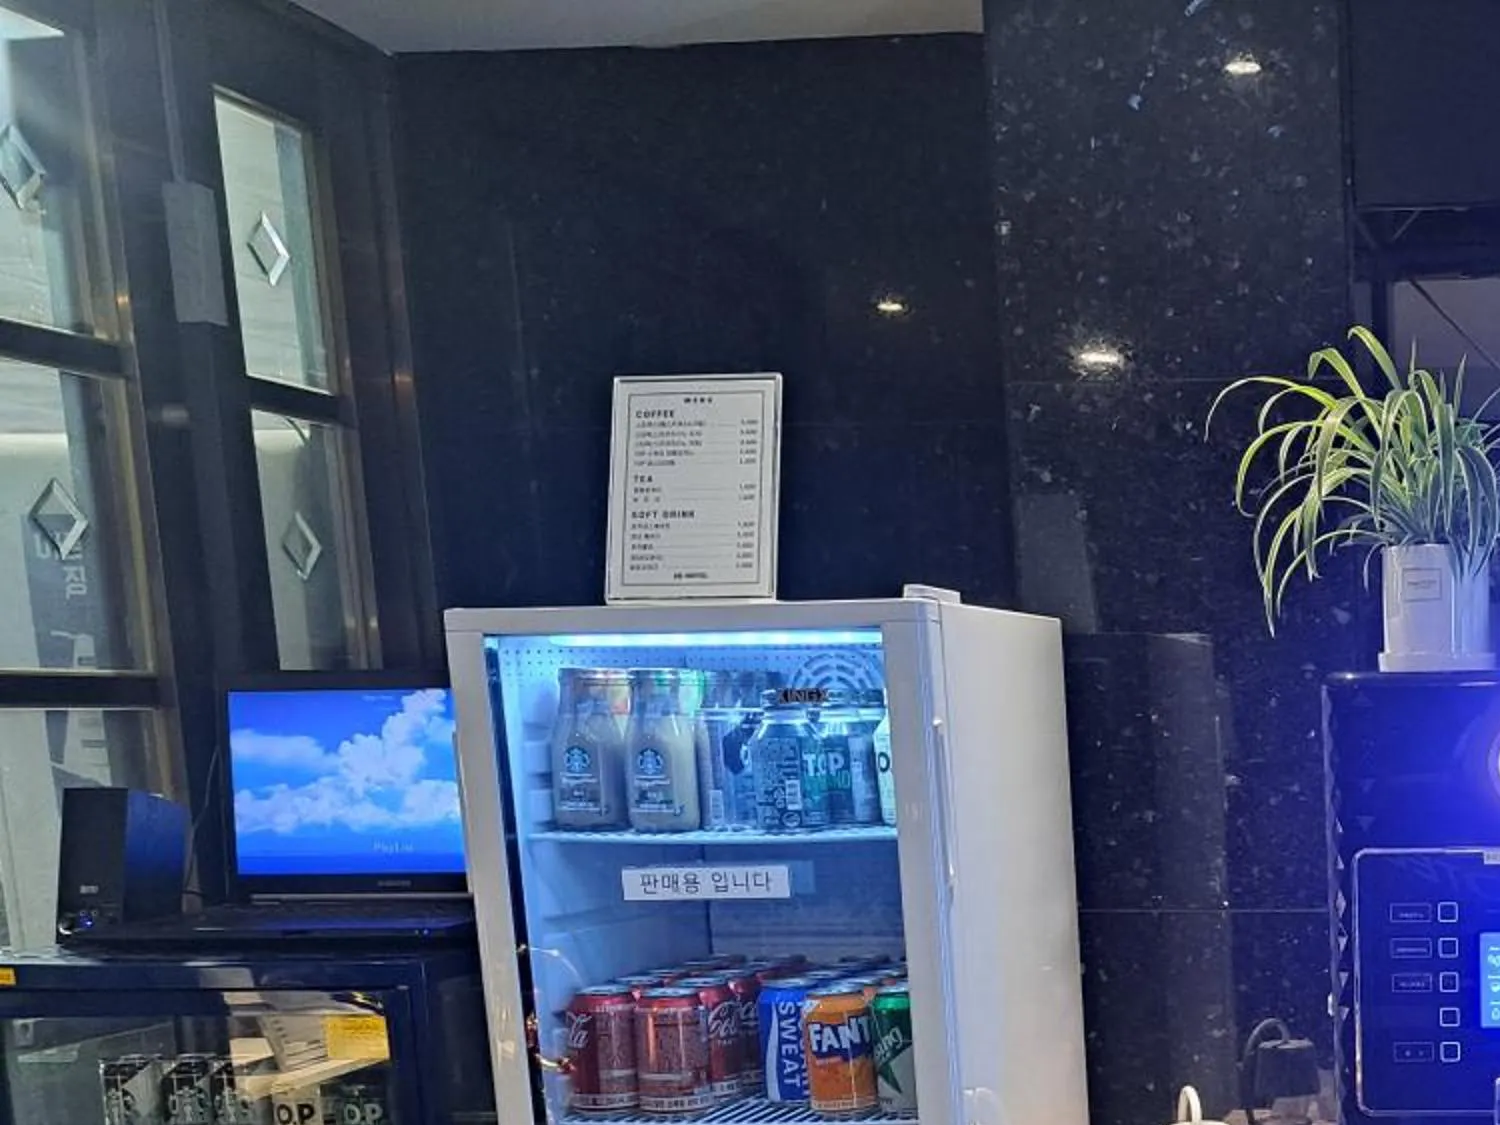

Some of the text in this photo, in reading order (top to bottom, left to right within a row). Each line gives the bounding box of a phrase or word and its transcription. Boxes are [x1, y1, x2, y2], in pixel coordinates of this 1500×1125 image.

[635, 409, 675, 419] COFFEE
[633, 474, 653, 483] TEA
[631, 509, 695, 519] SOFT DRINK
[639, 870, 773, 895] 판매용 입니다
[807, 1015, 873, 1053] FANT
[778, 1001, 801, 1088] SWEAT
